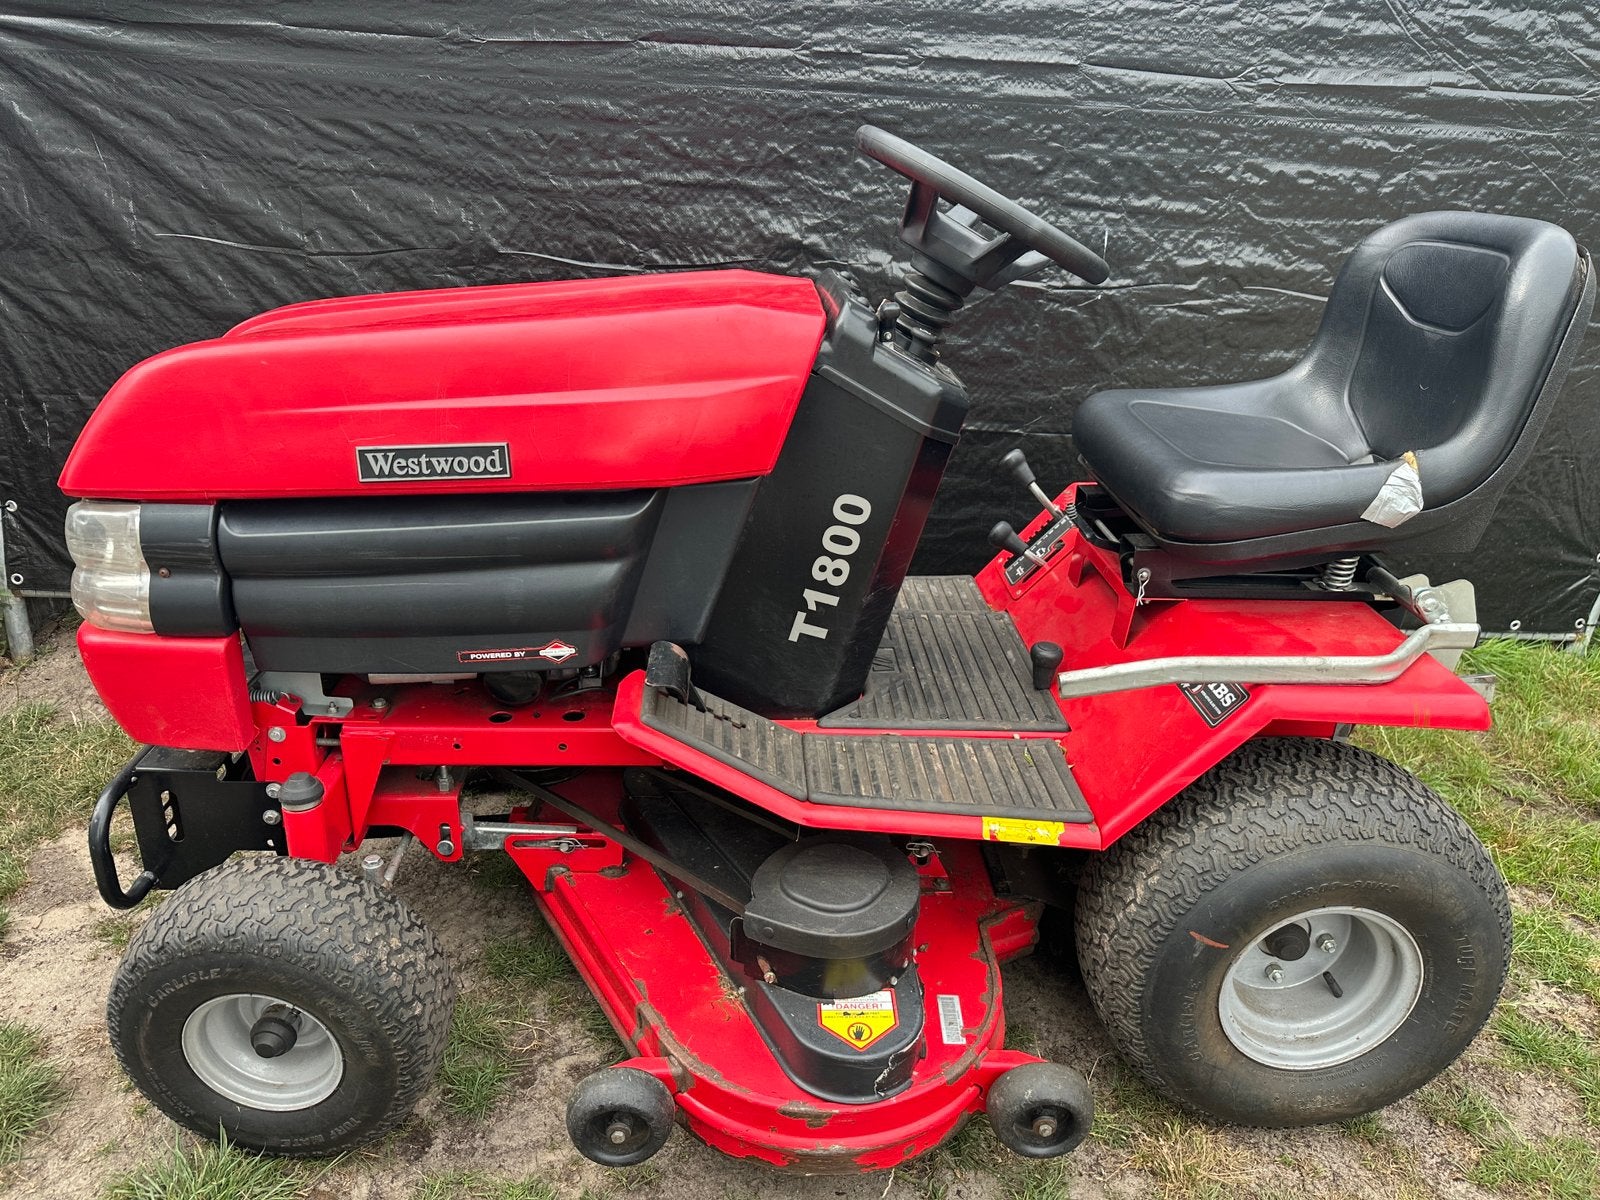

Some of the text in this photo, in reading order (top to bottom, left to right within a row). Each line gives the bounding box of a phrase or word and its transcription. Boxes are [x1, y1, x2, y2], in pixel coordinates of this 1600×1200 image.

[365, 449, 503, 476] Westwood
[788, 493, 872, 643] T1800
[470, 652, 512, 660] POWERED
[146, 967, 221, 1008] CARLISLE
